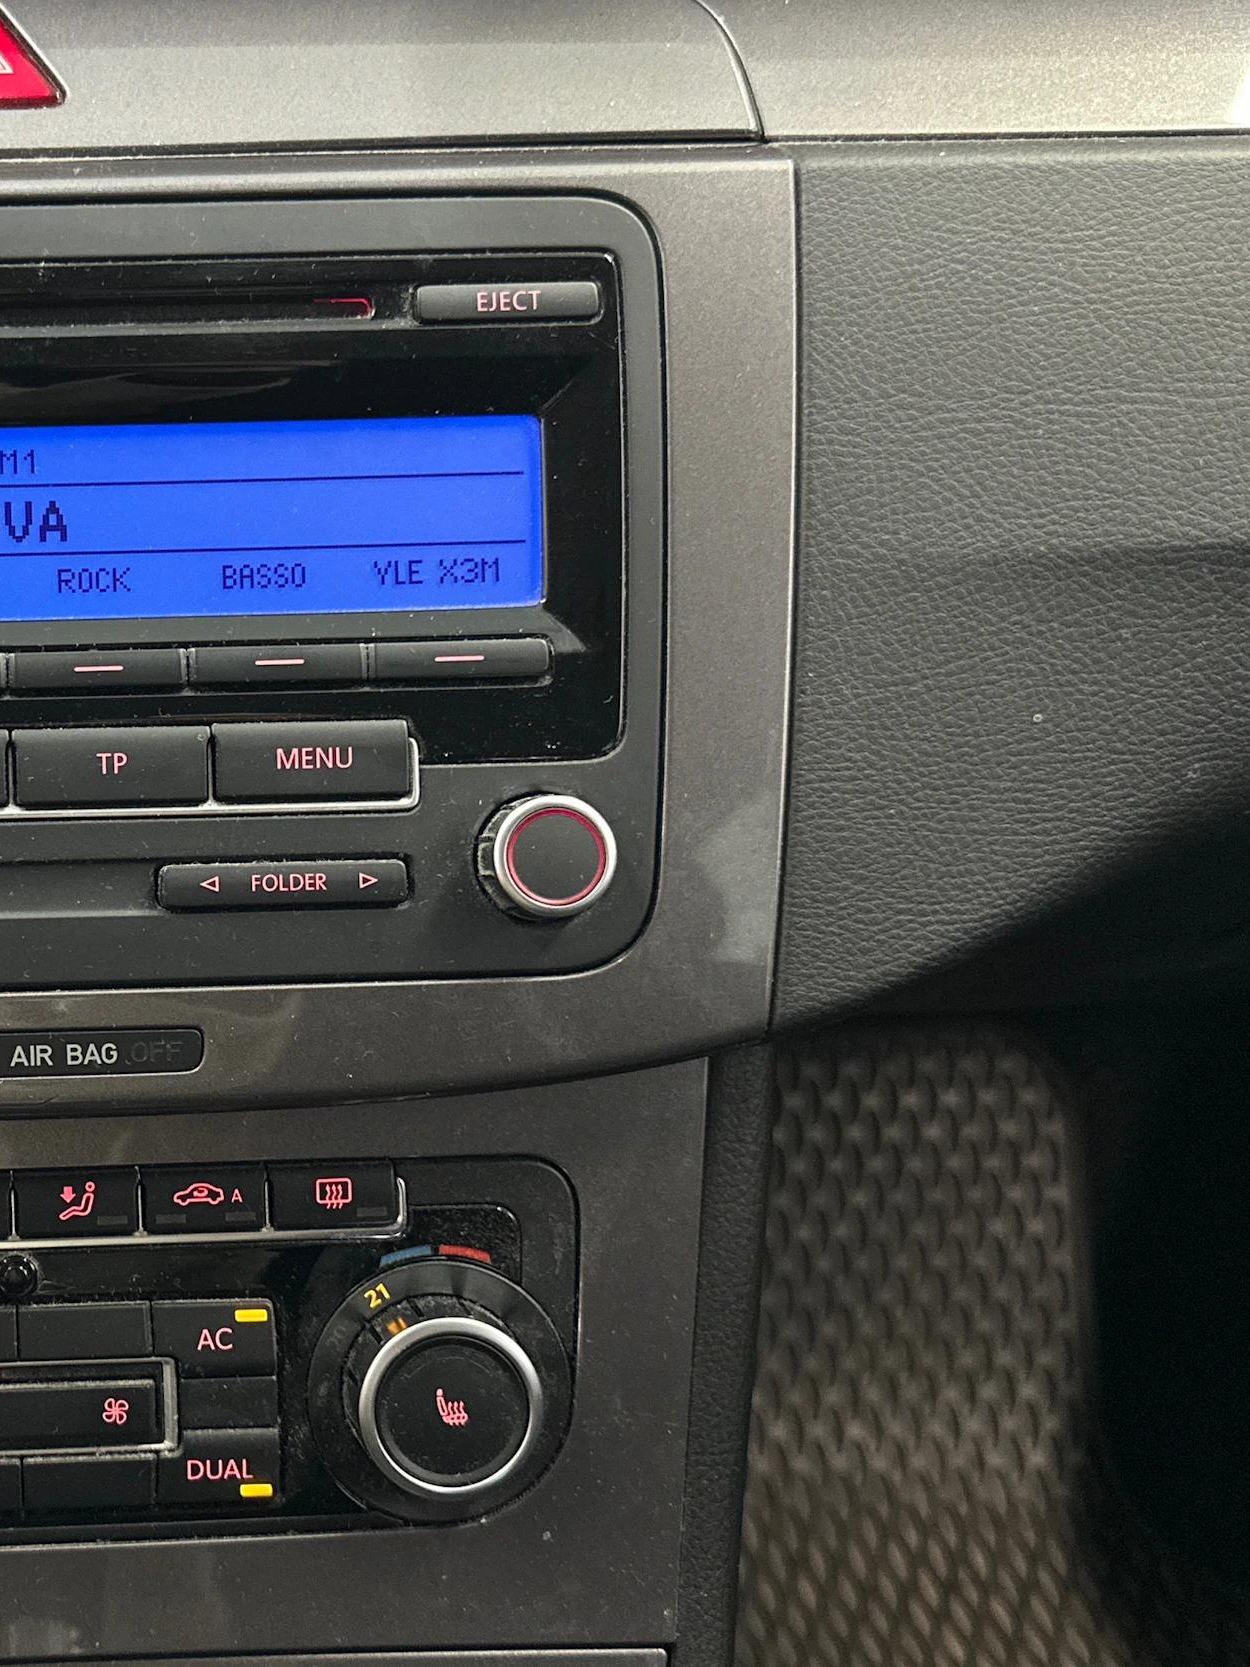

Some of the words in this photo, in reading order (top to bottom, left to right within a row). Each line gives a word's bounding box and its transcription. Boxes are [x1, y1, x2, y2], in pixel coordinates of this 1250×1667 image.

[475, 290, 542, 313] EJECT
[57, 567, 131, 594] ROCK
[222, 562, 306, 590] BASSO
[373, 559, 424, 586] YLE
[438, 557, 500, 584] X3M
[96, 752, 128, 775] TP
[276, 746, 353, 770] MENU
[251, 872, 327, 892] FOLDER
[10, 1044, 54, 1067] AIR
[66, 1042, 118, 1066] BAG
[231, 1188, 243, 1203] A
[363, 1282, 391, 1309] 21
[197, 1327, 233, 1351] AC
[186, 1458, 254, 1481] DUAL
